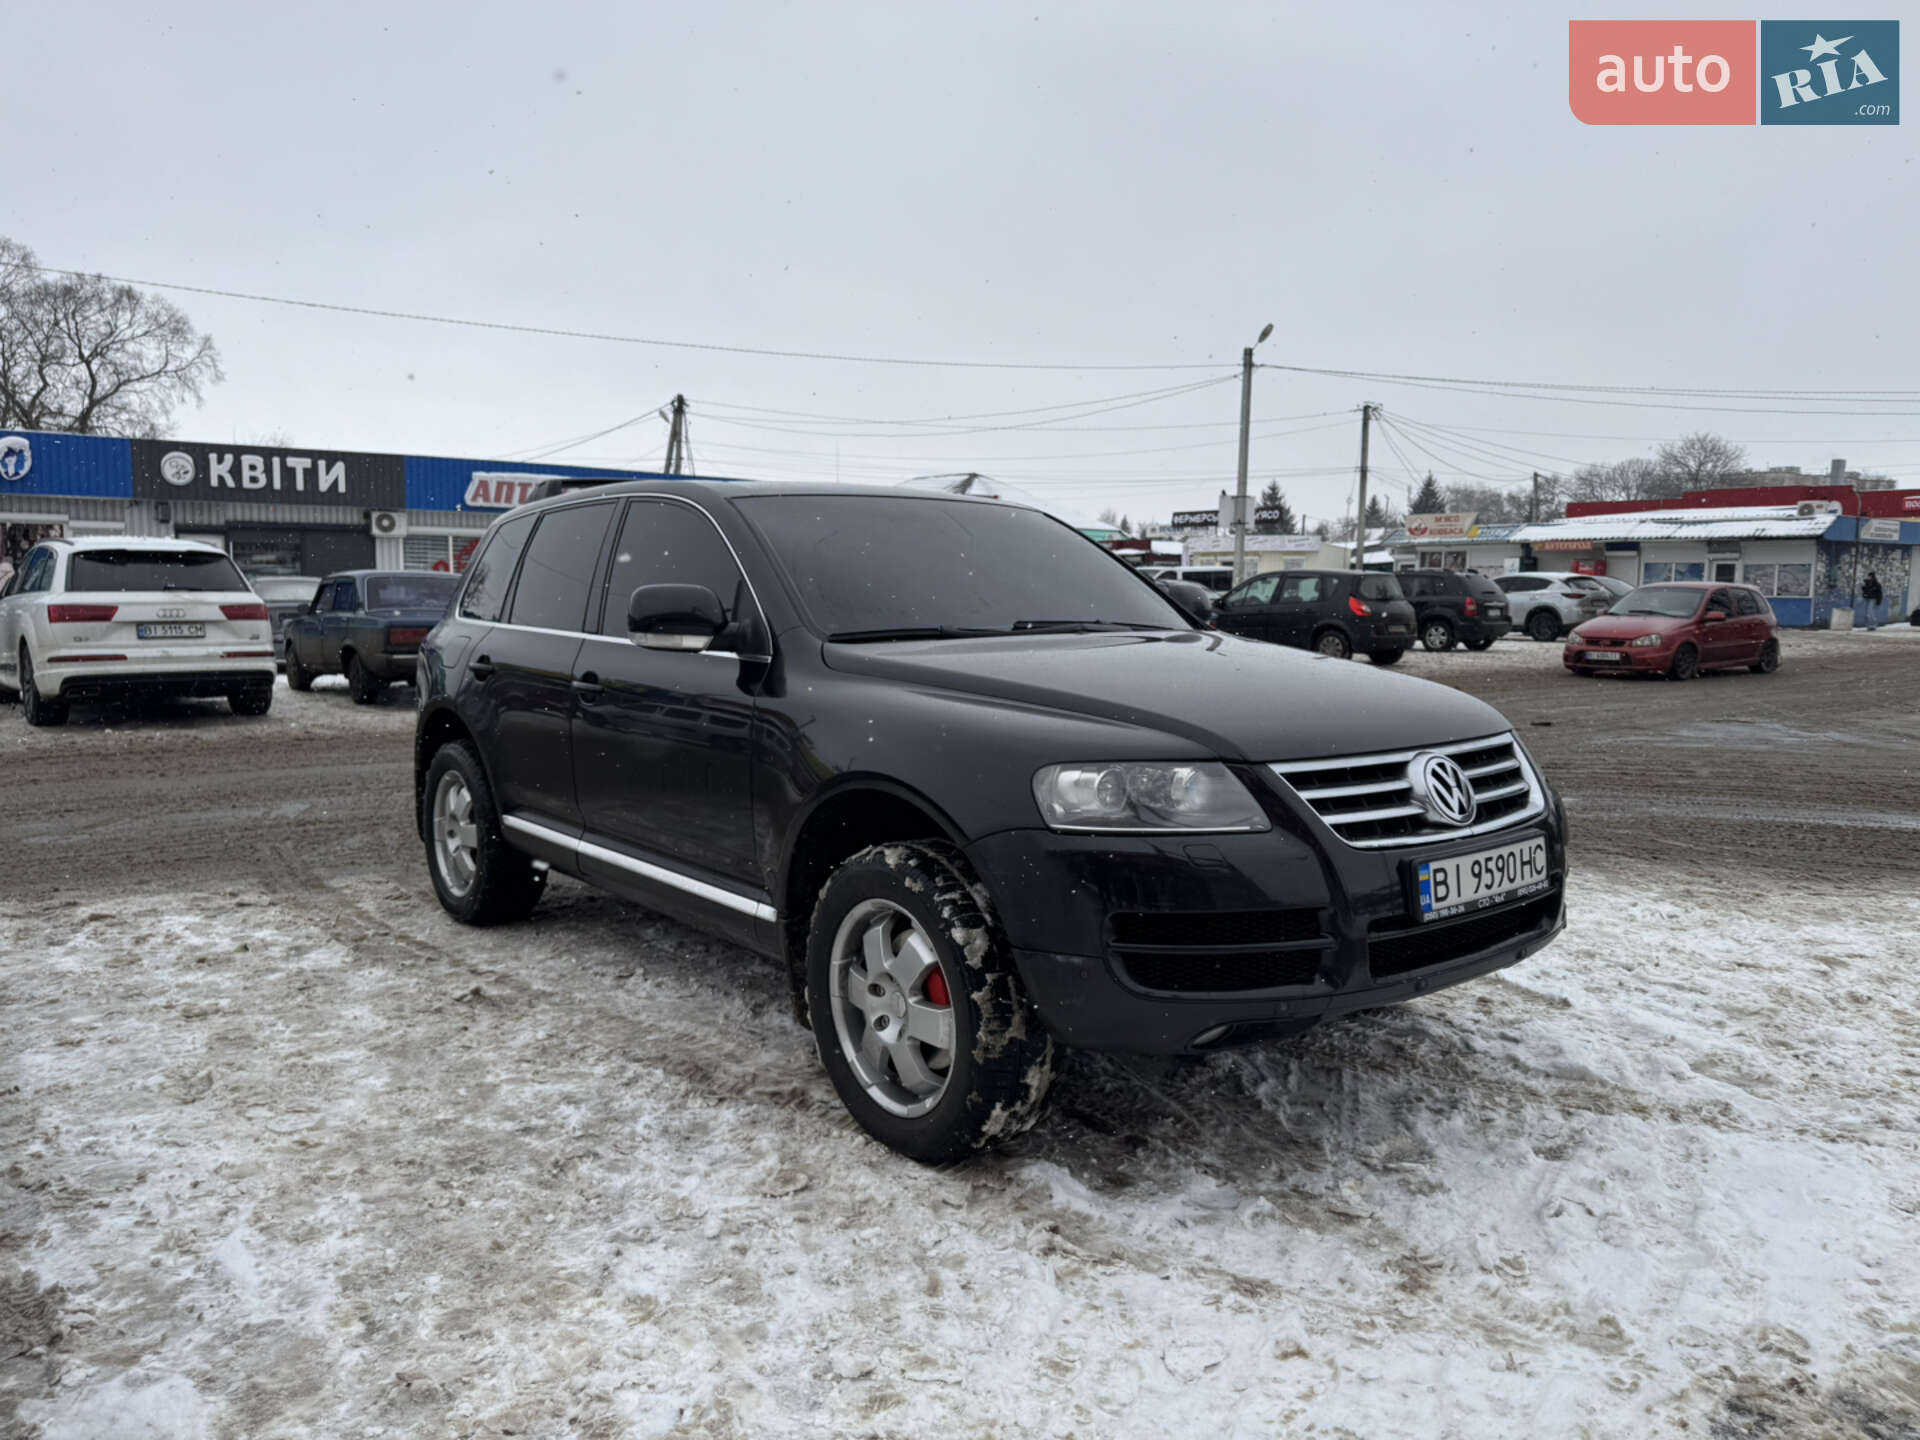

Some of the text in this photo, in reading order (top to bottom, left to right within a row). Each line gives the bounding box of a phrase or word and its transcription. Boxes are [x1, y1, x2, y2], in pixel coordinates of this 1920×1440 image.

[208, 452, 347, 493] КВІТИ
[470, 479, 534, 505] АПТ
[1432, 844, 1545, 904] BI 9590 HC
